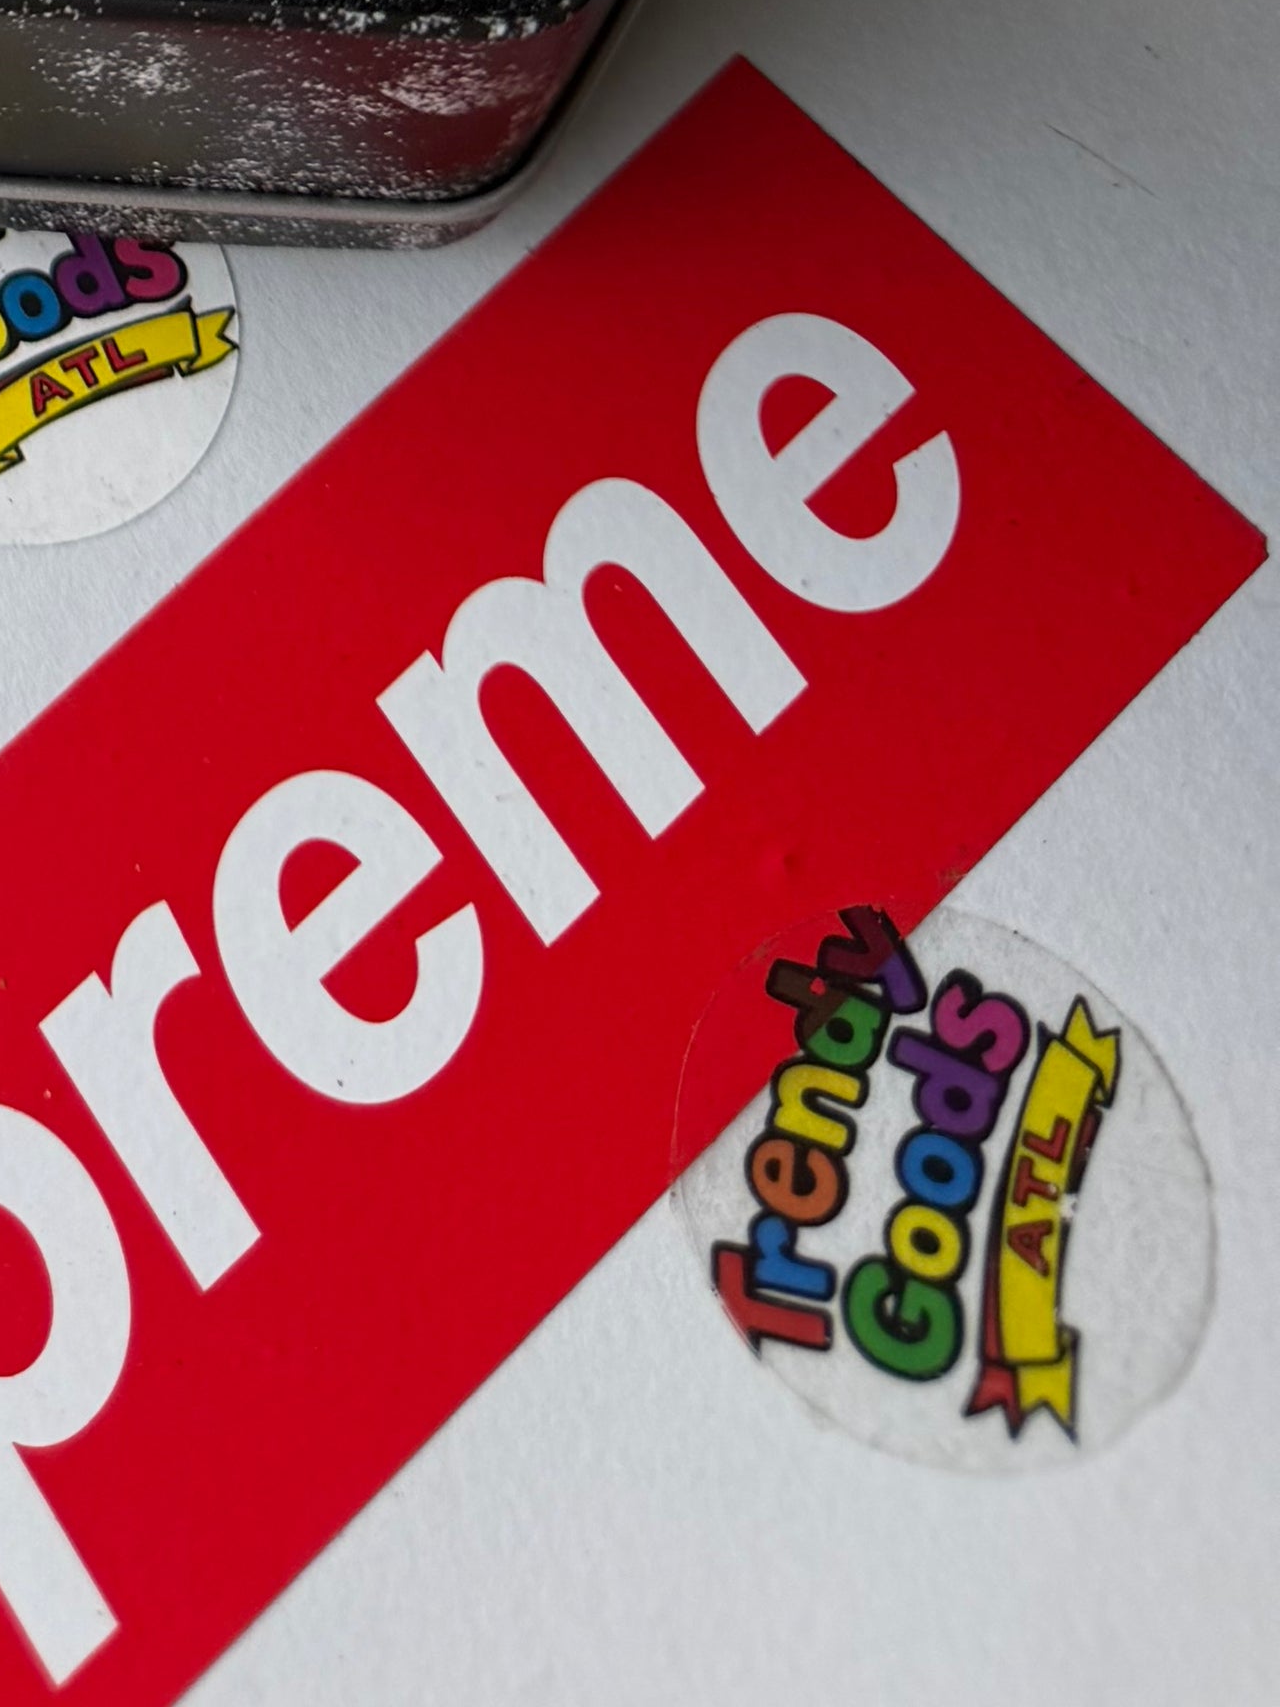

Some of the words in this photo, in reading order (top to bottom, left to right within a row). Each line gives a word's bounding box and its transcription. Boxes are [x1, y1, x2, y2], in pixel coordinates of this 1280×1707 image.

[28, 335, 148, 417] ATL
[711, 903, 928, 1359] Trendy
[839, 967, 1032, 1382] Goods
[1006, 1114, 1075, 1279] ATL
